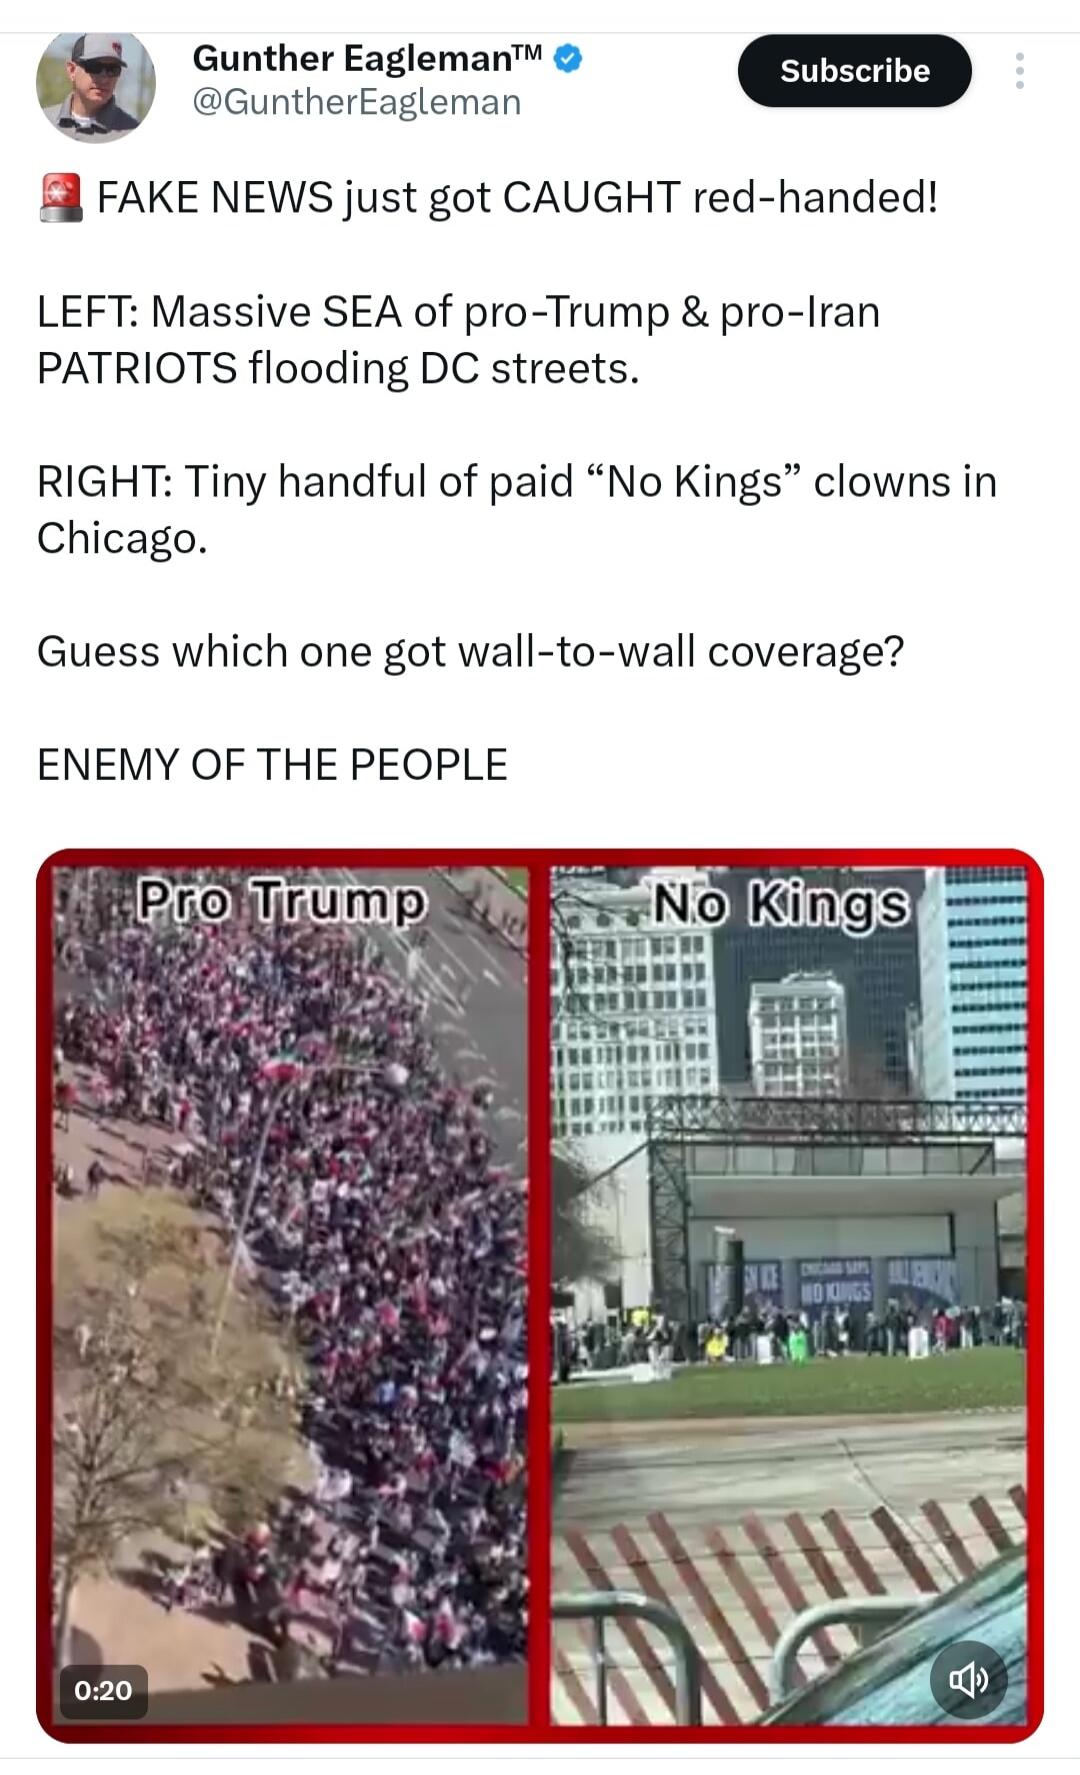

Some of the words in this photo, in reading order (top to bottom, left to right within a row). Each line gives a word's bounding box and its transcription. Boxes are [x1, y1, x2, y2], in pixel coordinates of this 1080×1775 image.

[194, 43, 335, 72] Gunther
[780, 57, 931, 83] Subscribe
[193, 87, 521, 121] @GuntherEagleman
[99, 181, 199, 214] FAKE
[213, 181, 333, 214] NEWS
[341, 180, 418, 222] just
[428, 181, 492, 223] got
[503, 180, 682, 214] CAUGHT
[695, 179, 937, 214] red-handed!
[39, 294, 138, 328] LEFT:
[153, 294, 311, 328] Massive
[323, 294, 403, 328] SEA
[414, 293, 454, 328] of
[466, 294, 670, 337] pro-Trump
[681, 294, 710, 328] &
[722, 294, 879, 337] pro-Iran
[39, 351, 237, 385] PATRIOTS
[248, 350, 409, 394] flooding
[422, 351, 479, 385] DC
[491, 352, 639, 385] streets.
[39, 464, 172, 498] RIGHT:
[184, 463, 267, 507] Tiny
[280, 463, 425, 498] handful
[439, 463, 479, 498] of
[491, 463, 572, 507] paid
[814, 463, 951, 498] clowns
[964, 463, 996, 498] in
[38, 519, 207, 563] Chicago.
[38, 634, 160, 668] Guess
[172, 633, 287, 668] which
[300, 642, 372, 668] one
[383, 636, 447, 677] got
[458, 633, 694, 668] wall-to-wall
[708, 634, 905, 677] coverage?
[39, 747, 180, 781] ENEMY
[191, 747, 246, 781] OF
[256, 747, 338, 781] THE
[352, 747, 508, 781] PEOPLE
[826, 1281, 872, 1303] KINGS
